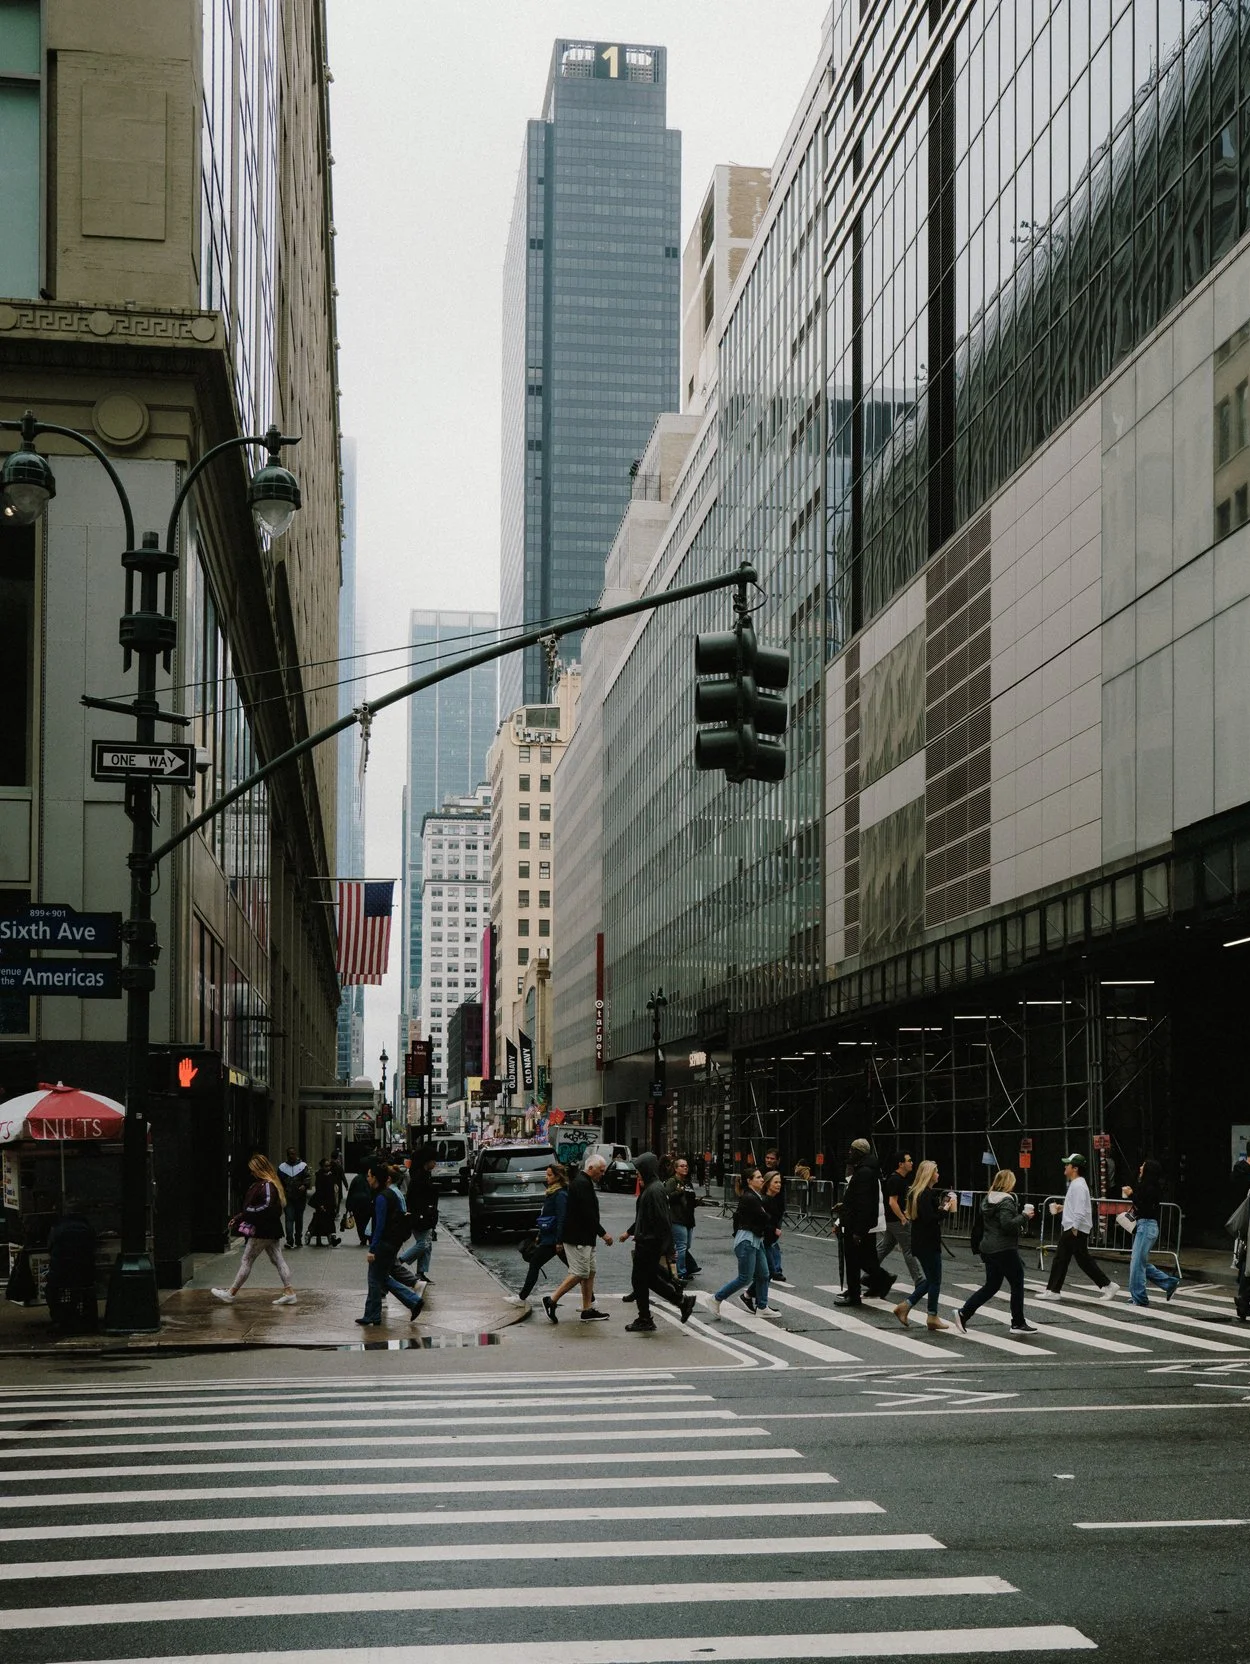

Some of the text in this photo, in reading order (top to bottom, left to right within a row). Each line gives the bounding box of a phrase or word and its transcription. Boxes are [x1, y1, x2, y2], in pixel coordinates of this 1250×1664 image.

[601, 45, 619, 79] 1
[111, 754, 177, 768] ONE WAY
[0, 921, 96, 941] Sixth Ave
[0, 968, 21, 976] enue
[1, 976, 16, 985] the
[22, 967, 105, 987] Americas
[508, 1055, 517, 1089] OLD NAVY
[522, 1048, 533, 1084] OLD NAVY
[42, 1118, 103, 1140] NUTS
